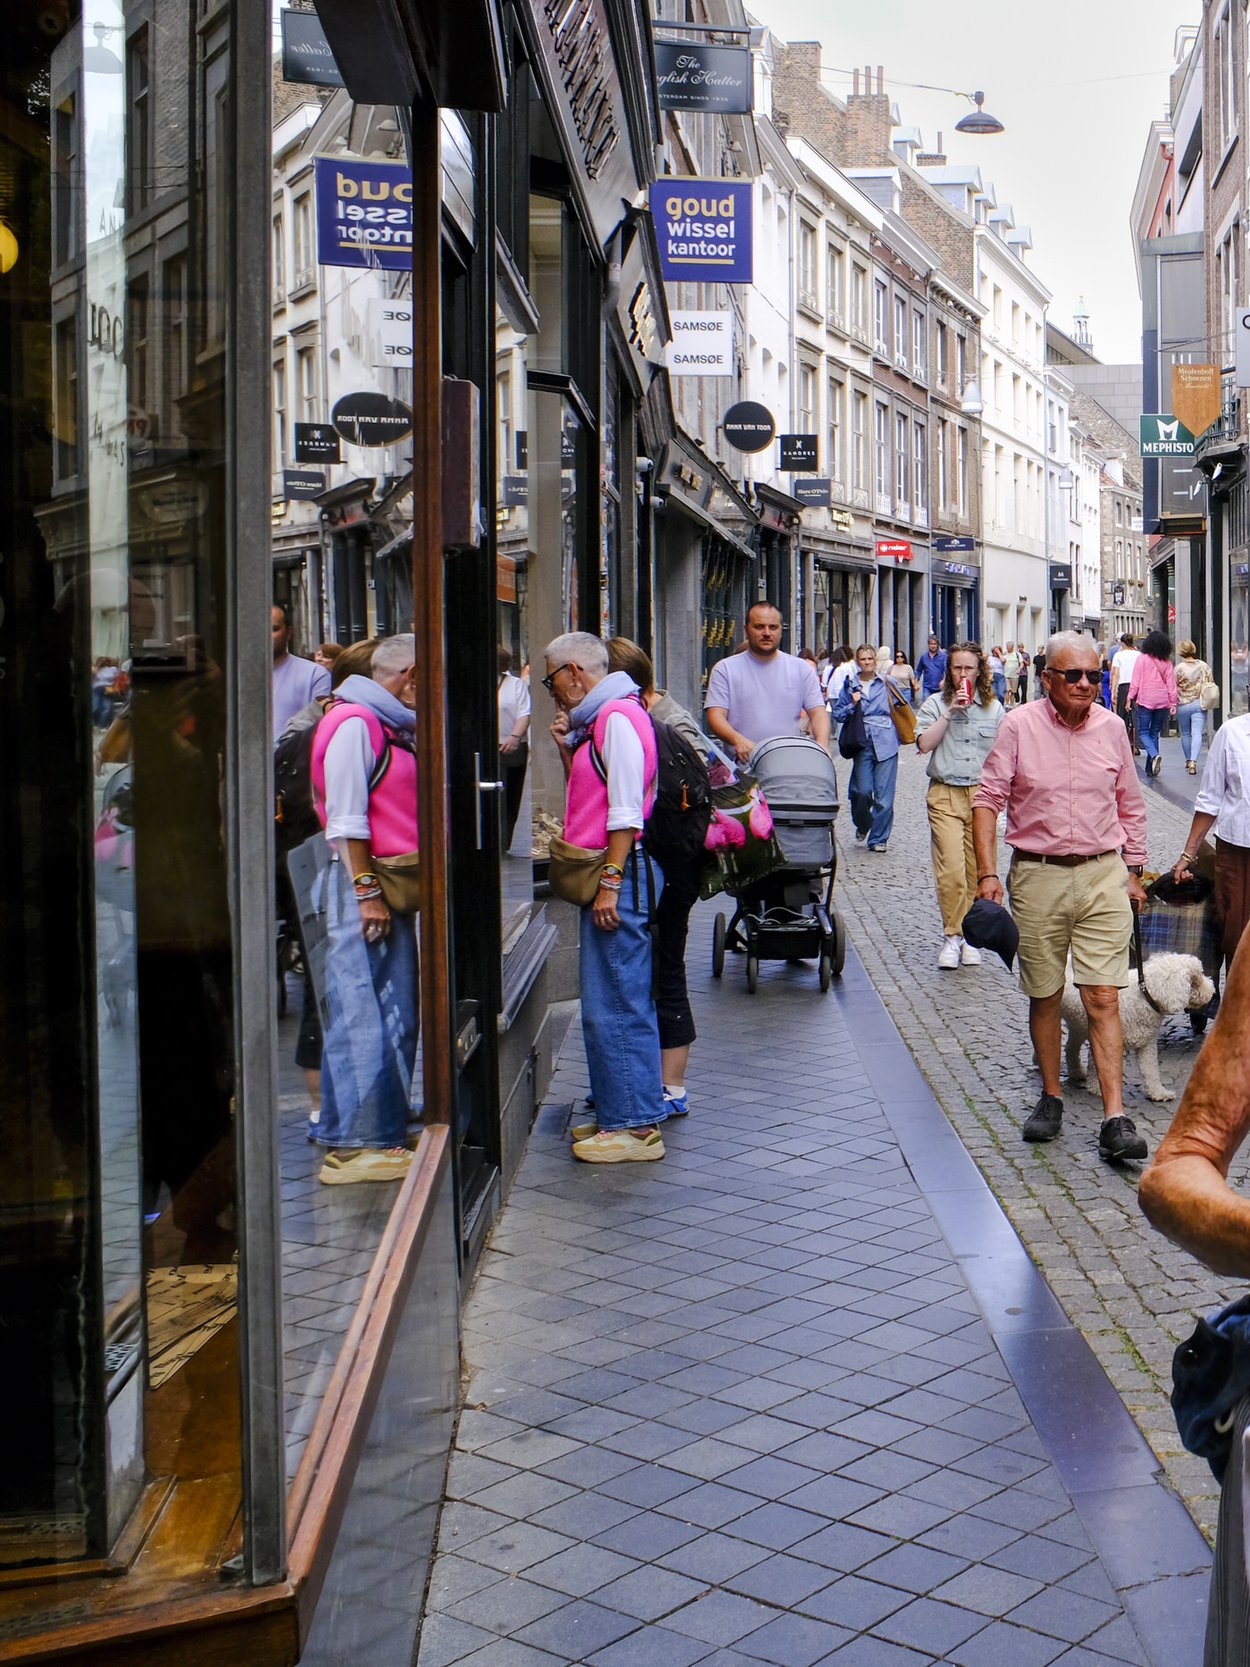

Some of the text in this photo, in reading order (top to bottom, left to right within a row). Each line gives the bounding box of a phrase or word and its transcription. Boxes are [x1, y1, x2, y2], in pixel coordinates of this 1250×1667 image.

[676, 55, 700, 68] The
[656, 70, 743, 86] glish Hatter
[665, 194, 735, 221] goud
[666, 217, 735, 238] wissel
[667, 239, 736, 256] kantoor
[673, 321, 724, 331] SAMSØE
[673, 354, 724, 364] SAMSØE
[1142, 442, 1194, 453] MEPHISTO
